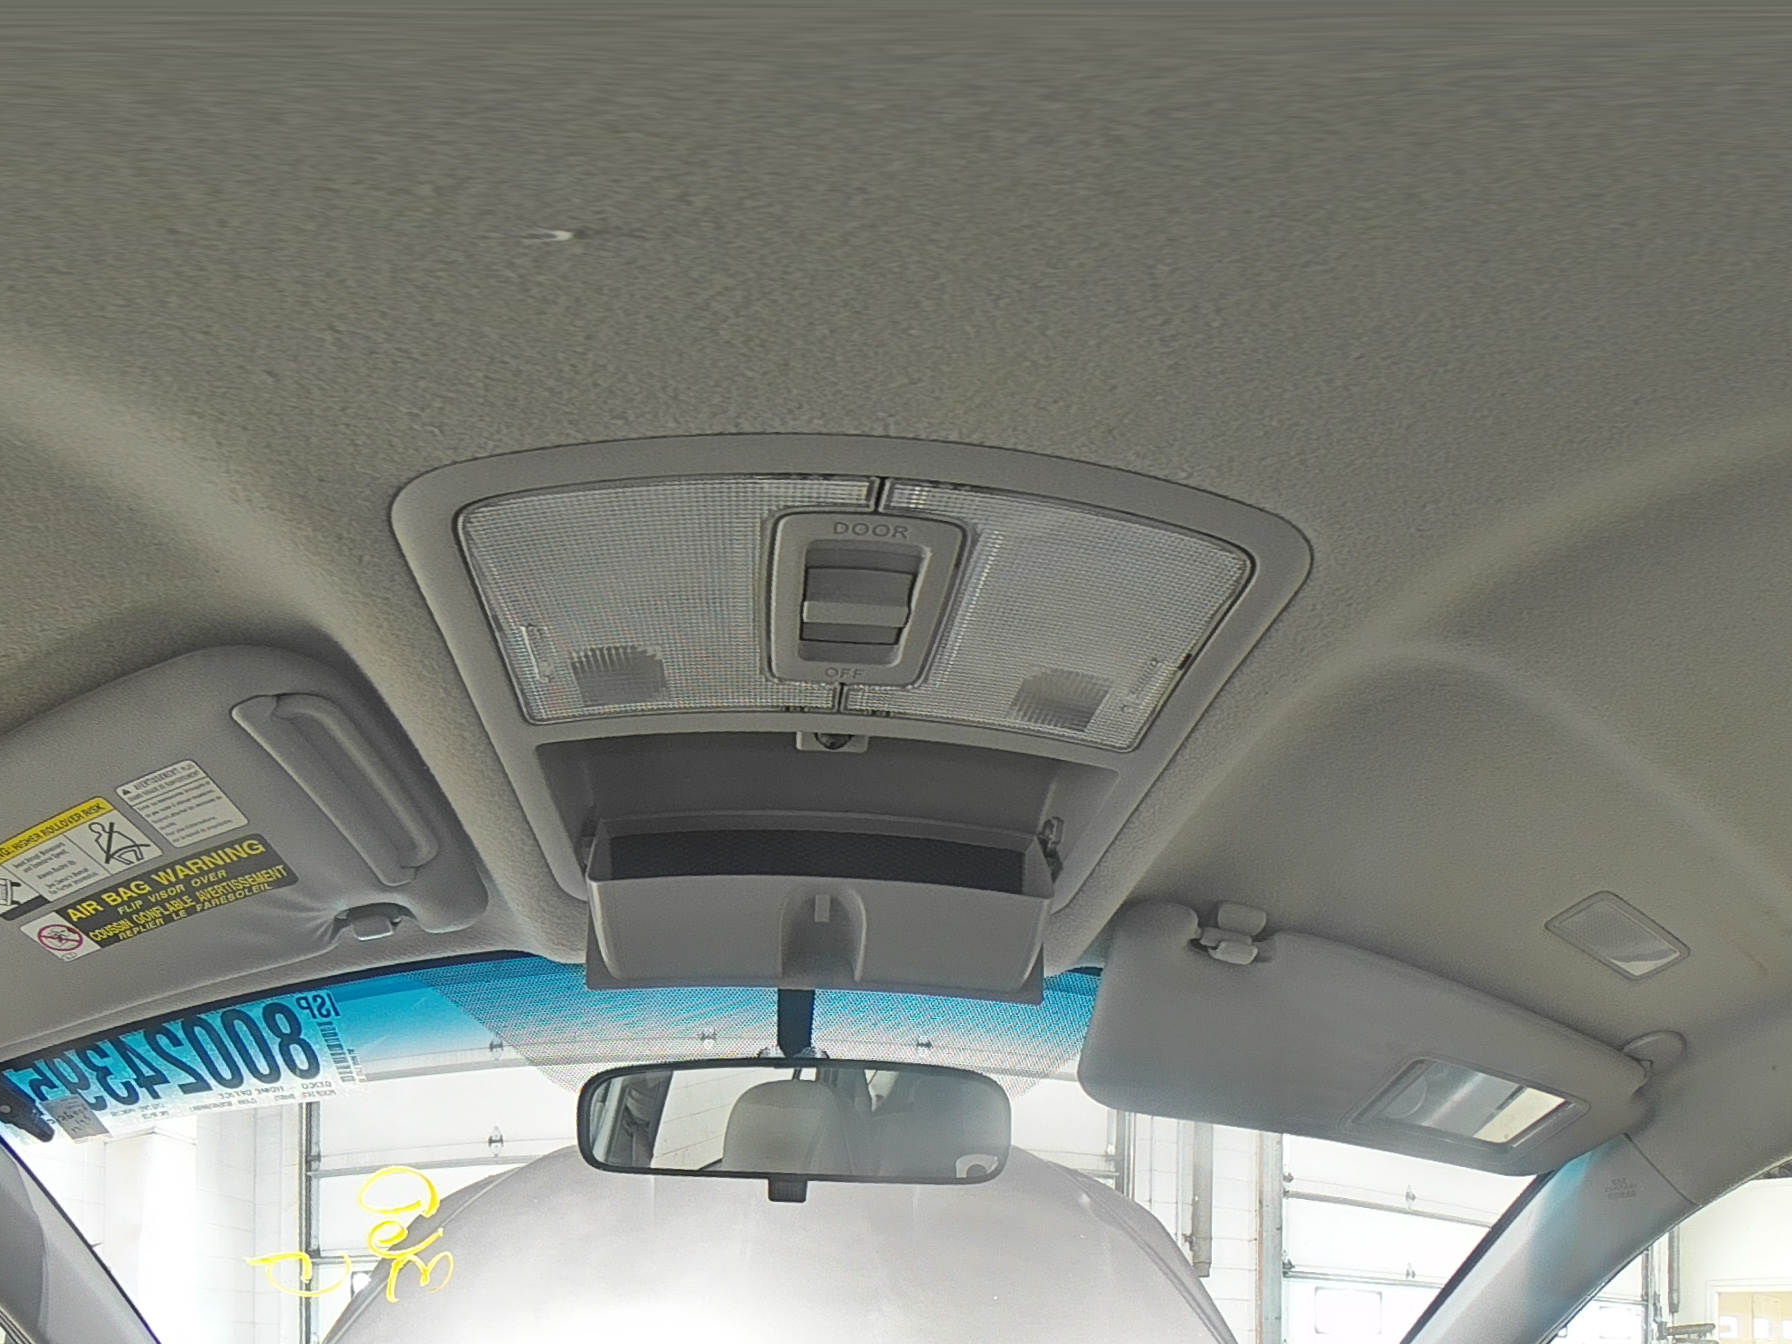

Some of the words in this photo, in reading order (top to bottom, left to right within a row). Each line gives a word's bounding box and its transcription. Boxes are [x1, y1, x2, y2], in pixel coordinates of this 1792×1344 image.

[833, 521, 910, 539] DOOR
[824, 666, 864, 679] OFF
[12, 832, 43, 851] HIGHER
[41, 812, 84, 837] ROLLOVER
[82, 802, 105, 818] RISK
[66, 899, 104, 922] AIR
[101, 880, 152, 907] BAG
[150, 839, 266, 887] WARNING
[88, 919, 134, 942] COUSSIN
[132, 895, 197, 926] GONFLABLE
[195, 864, 288, 902] AVERTISSEMENT
[117, 899, 144, 915] FLIP
[147, 884, 186, 903] VISOR
[191, 870, 228, 888] OVER
[118, 918, 165, 940] REPLIER
[172, 909, 188, 920] LE
